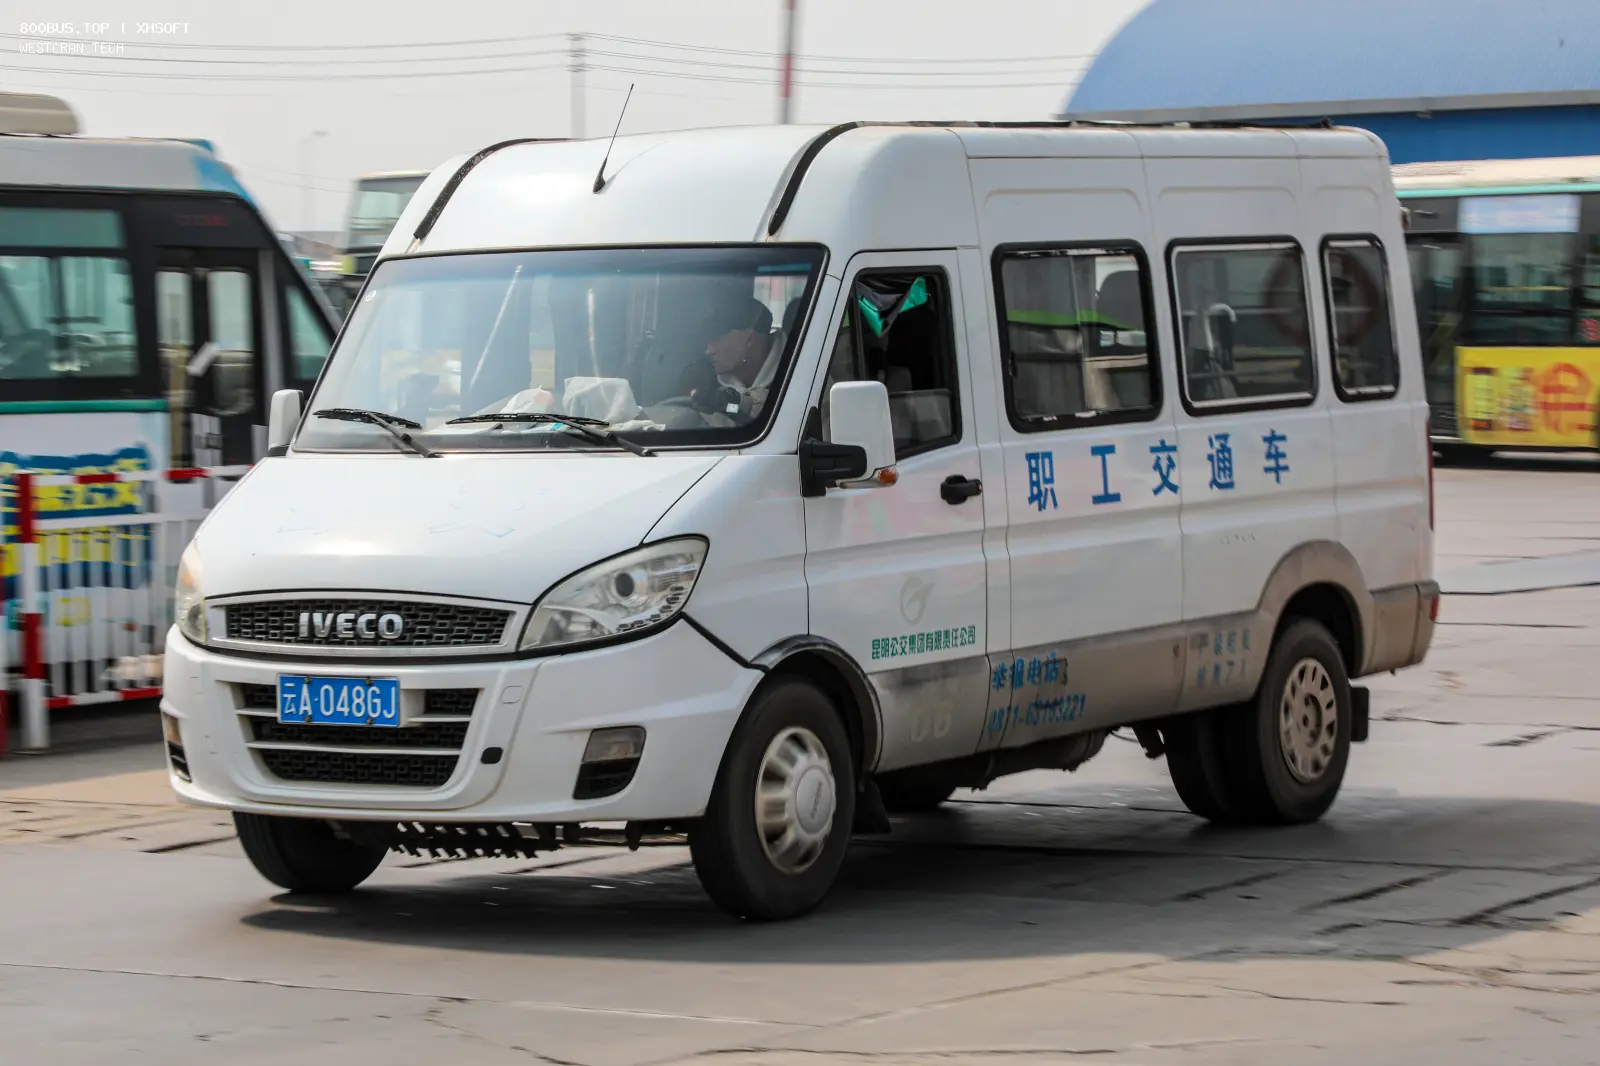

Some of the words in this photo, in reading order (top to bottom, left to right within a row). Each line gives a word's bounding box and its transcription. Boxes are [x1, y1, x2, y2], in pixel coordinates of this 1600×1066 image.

[1025, 428, 1290, 512] 职工交通车
[299, 612, 404, 640] IVECO
[871, 624, 976, 660] 昆明公交集团有限责任公司
